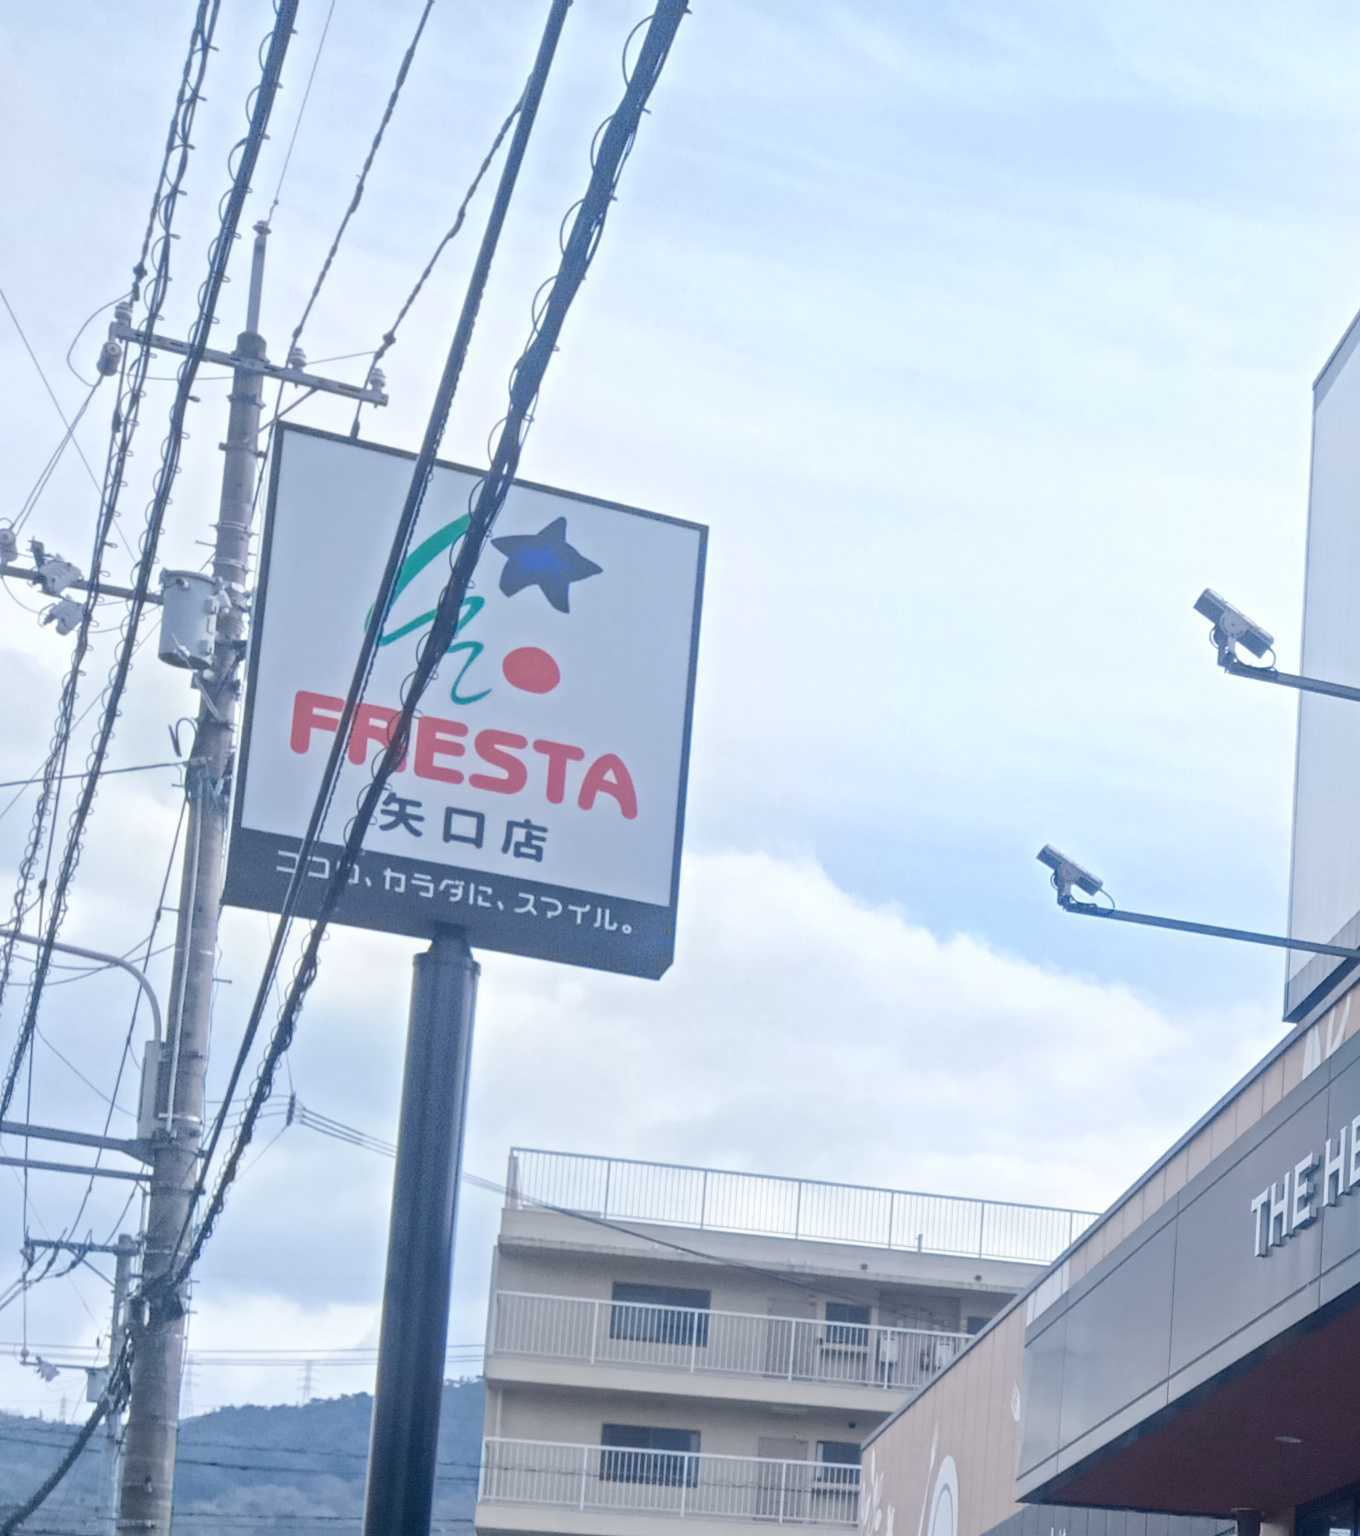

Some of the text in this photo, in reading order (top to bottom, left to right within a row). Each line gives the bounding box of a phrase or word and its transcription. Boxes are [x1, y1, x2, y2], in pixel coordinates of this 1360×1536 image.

[289, 690, 638, 820] FRESTA
[379, 792, 550, 863] 矢口店
[1250, 1152, 1320, 1258] THE
